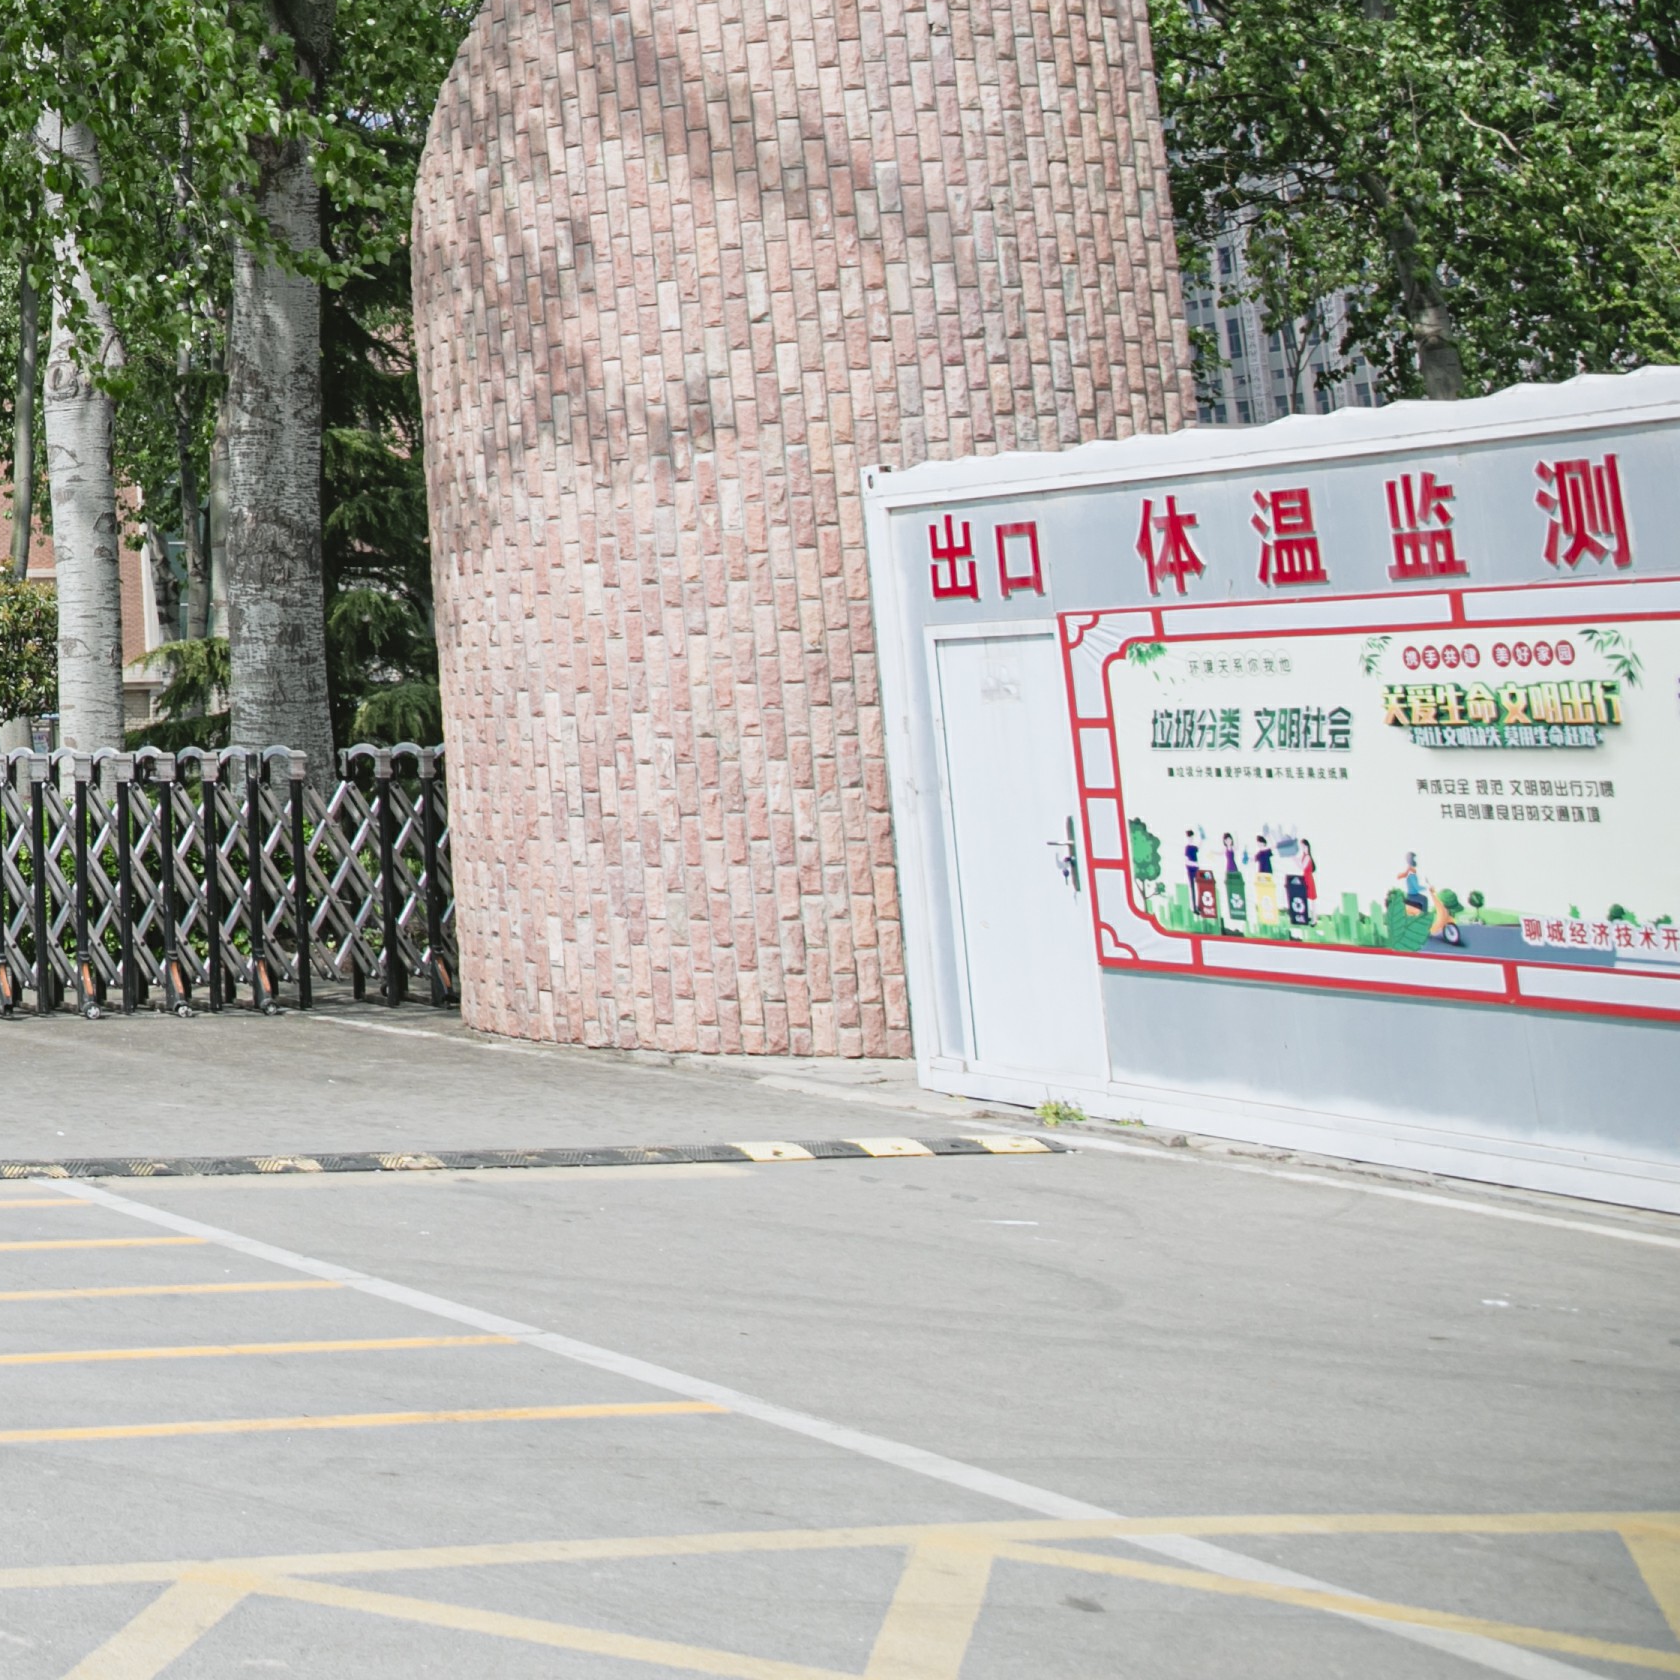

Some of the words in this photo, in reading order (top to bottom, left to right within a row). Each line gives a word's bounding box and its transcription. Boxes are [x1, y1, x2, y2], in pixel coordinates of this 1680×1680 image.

[928, 514, 1045, 601] 出口
[1135, 454, 1632, 596] 体温监测
[1189, 657, 1292, 674] 环境关系你我他
[1405, 646, 1479, 668] 携手共建
[1493, 642, 1574, 665] 美好家园
[1151, 707, 1240, 750] 垃圾分类
[1253, 705, 1353, 751] 文明社会
[1416, 778, 1470, 795] 养成安全
[1476, 779, 1504, 796] 规范
[1510, 779, 1615, 798] 文明的出行习惯
[1440, 803, 1602, 823] 共同创建良好的交通环境
[1522, 918, 1680, 952] 聊城经济技术开
